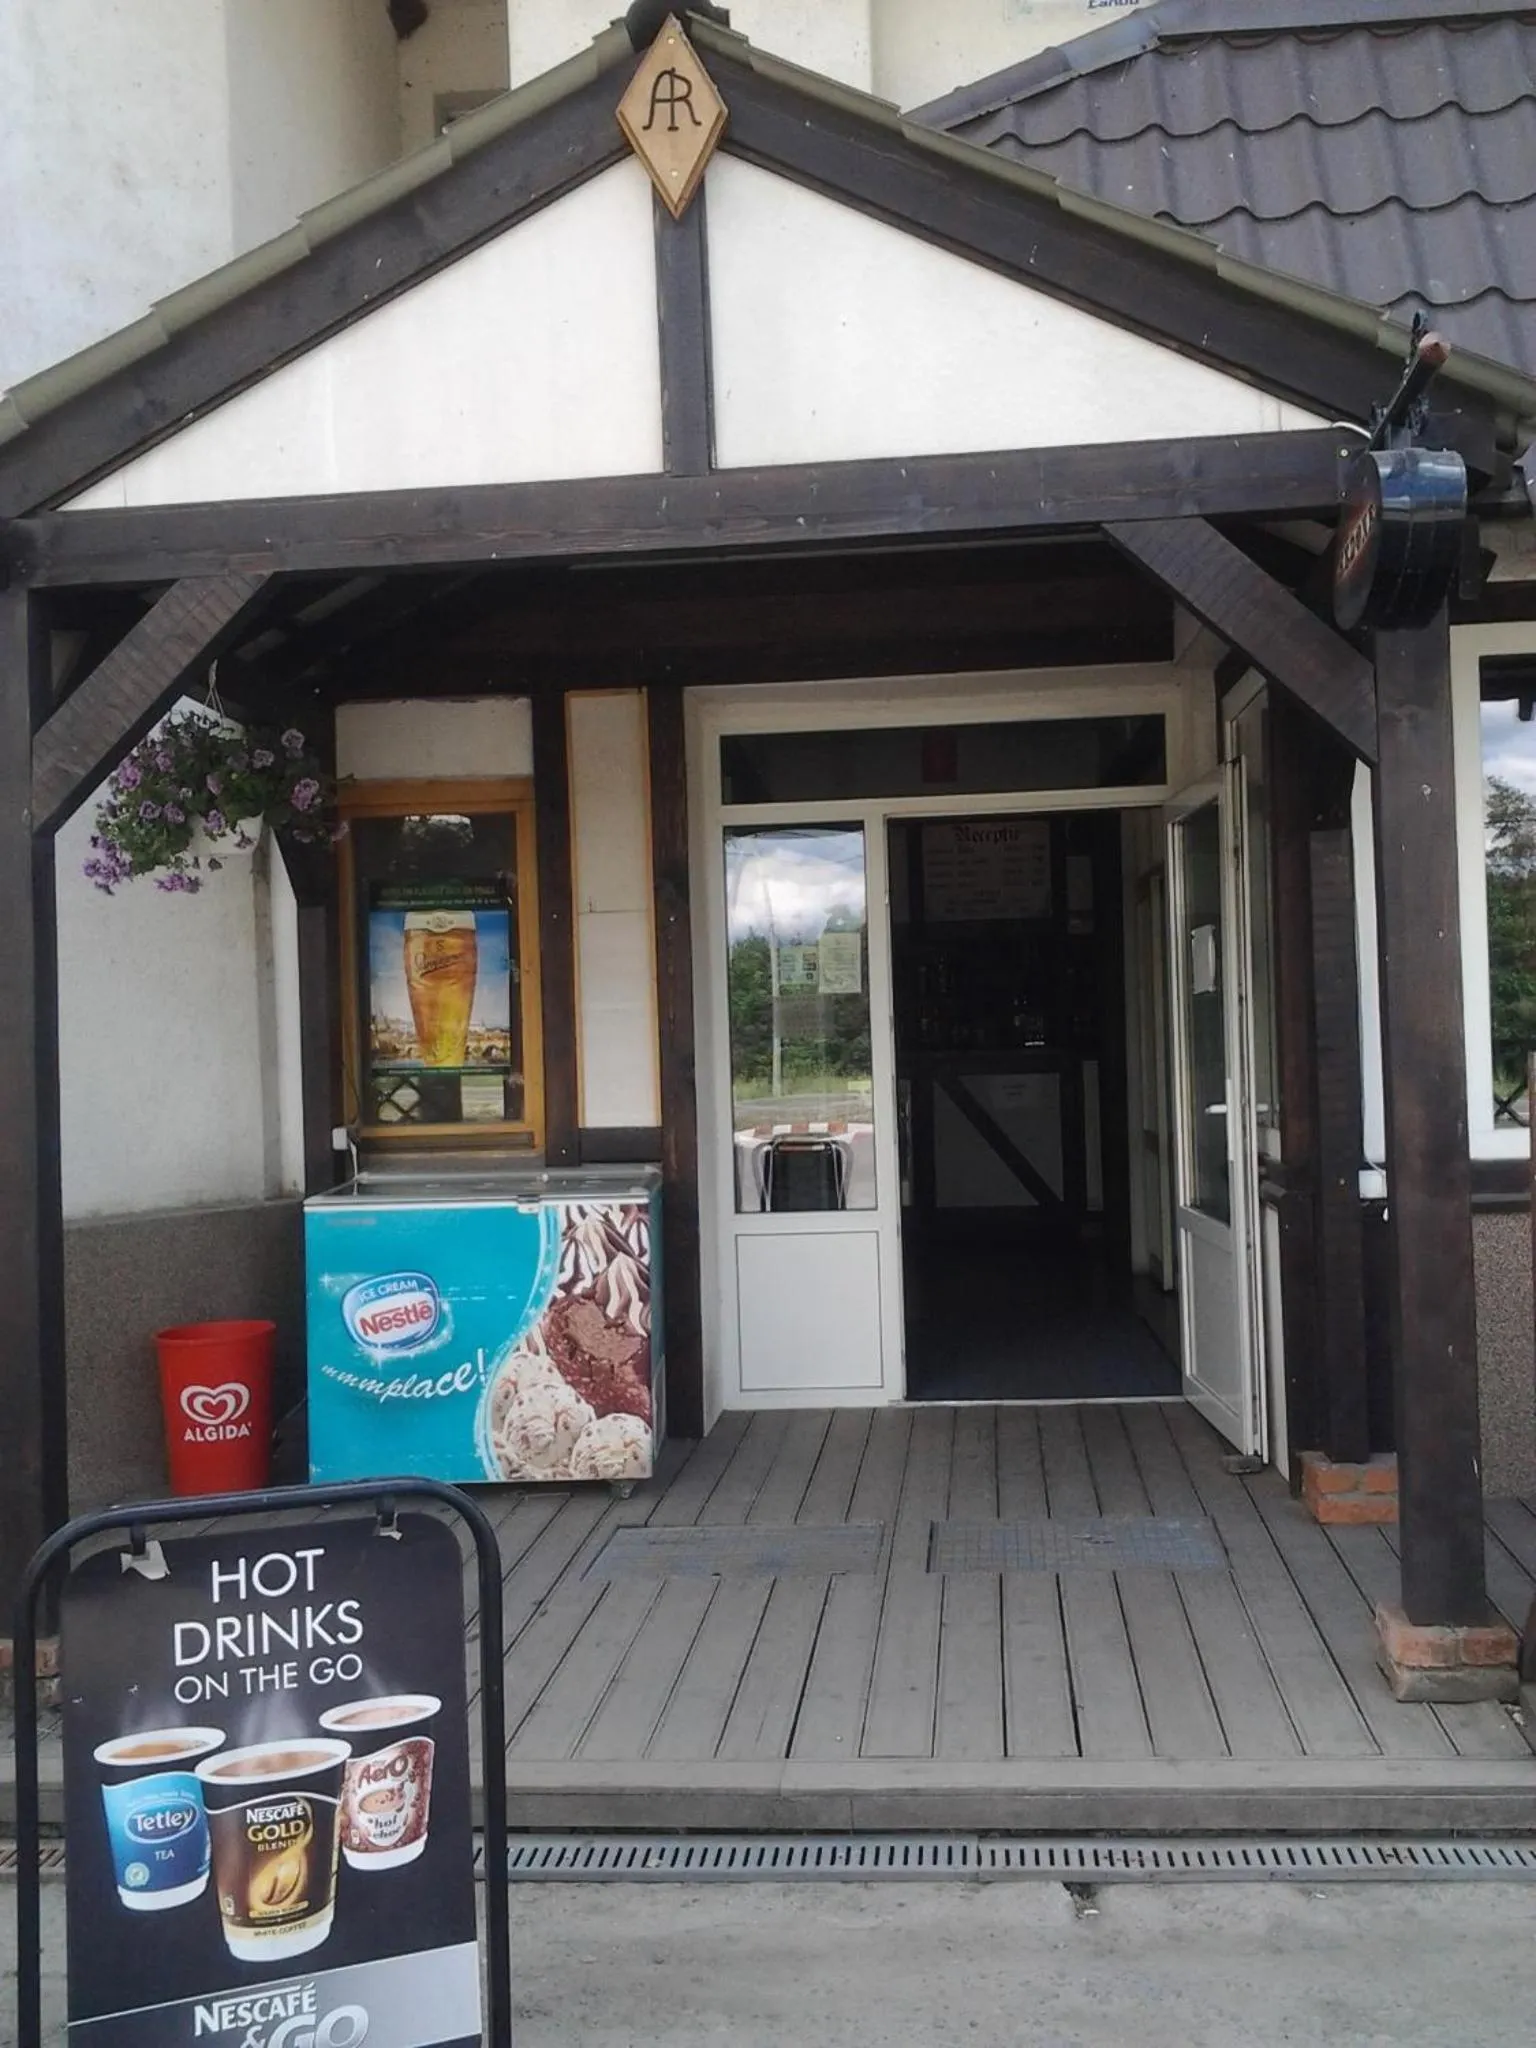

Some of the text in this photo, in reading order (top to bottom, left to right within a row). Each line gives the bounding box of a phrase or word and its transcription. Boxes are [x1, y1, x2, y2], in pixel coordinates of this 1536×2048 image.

[359, 1279, 419, 1303] ICE CREAM
[359, 1299, 433, 1337] Nestlé
[184, 1424, 251, 1442] ALGIDA
[211, 1547, 325, 1604] HOT
[174, 1599, 364, 1667] DRINKS
[174, 1653, 363, 1704] ON THE GO
[131, 1807, 194, 1833] Tetley
[247, 1820, 305, 1843] GOLD
[154, 1847, 176, 1862] TEA
[194, 1980, 318, 2037] NESCAFÉ
